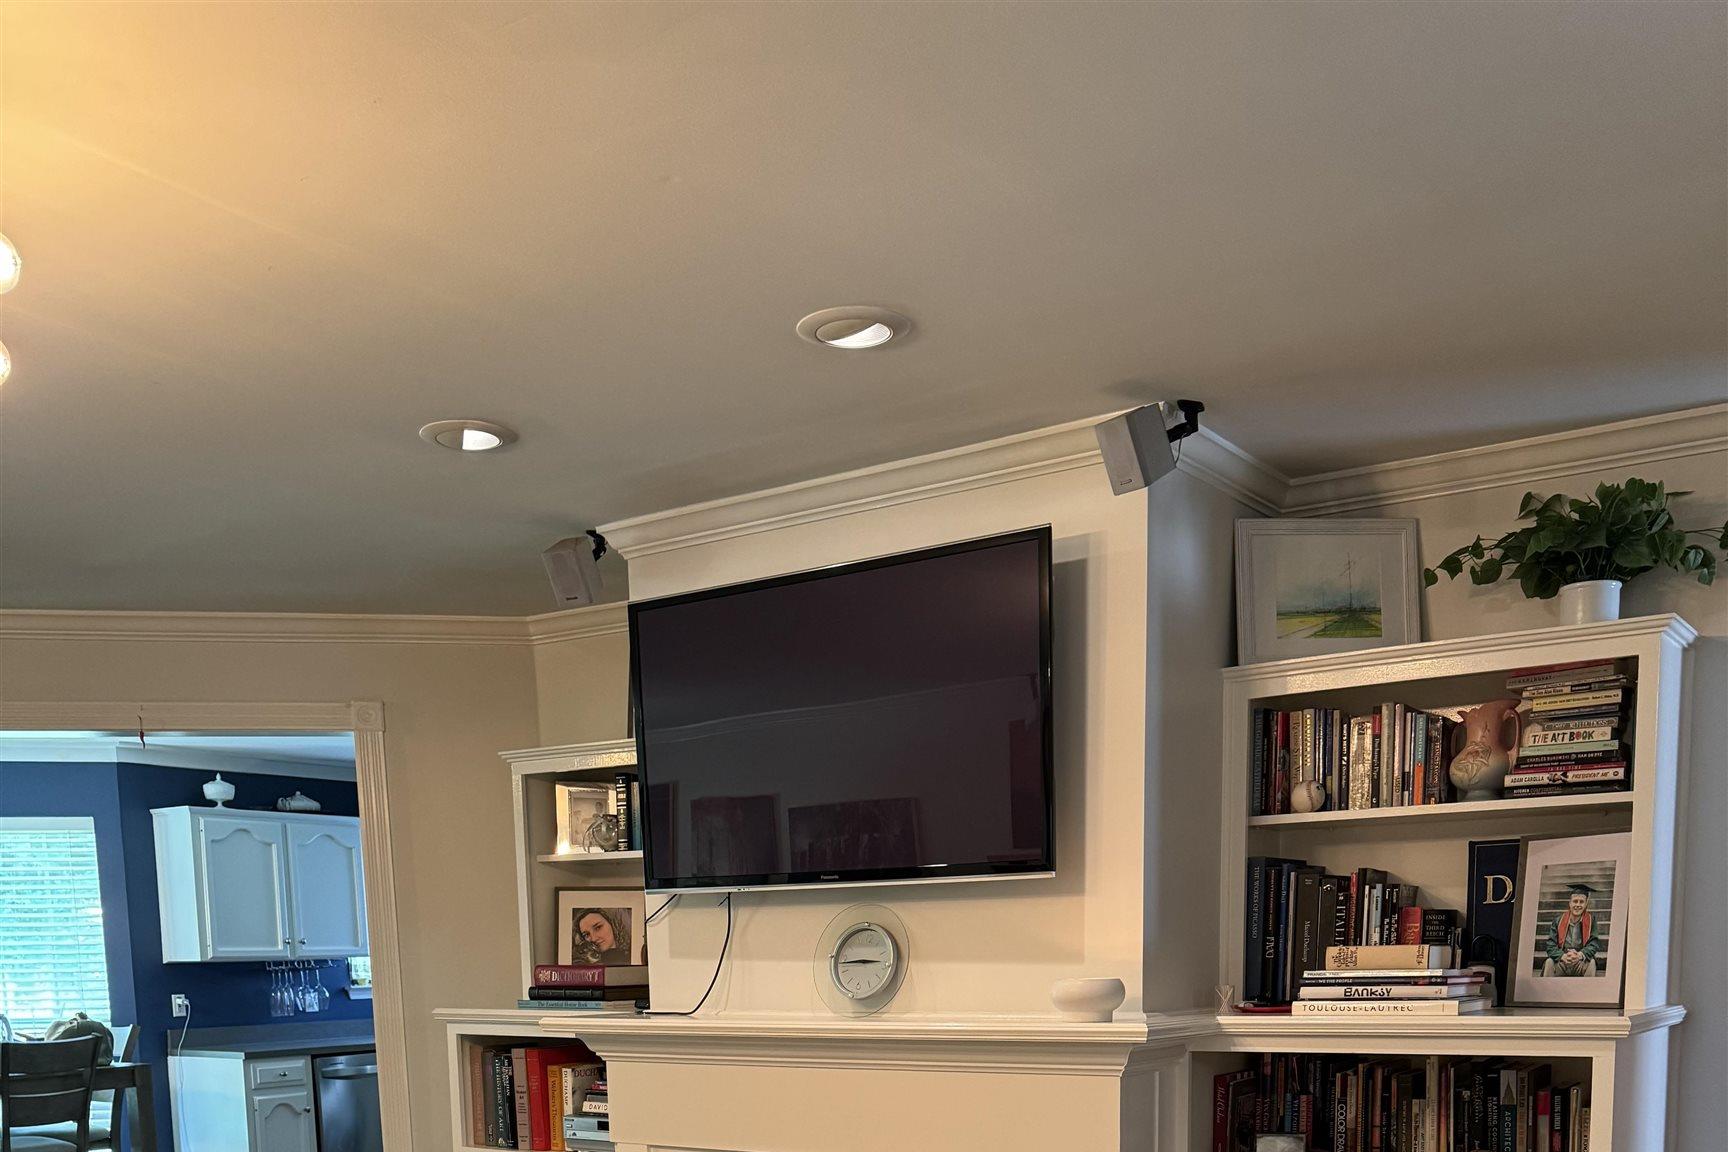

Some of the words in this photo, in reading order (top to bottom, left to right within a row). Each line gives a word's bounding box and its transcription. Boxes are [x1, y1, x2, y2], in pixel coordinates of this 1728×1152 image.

[1568, 730, 1596, 741] BOOK
[1343, 987, 1393, 998] BANKSY
[1337, 1104, 1346, 1132] COLOR
